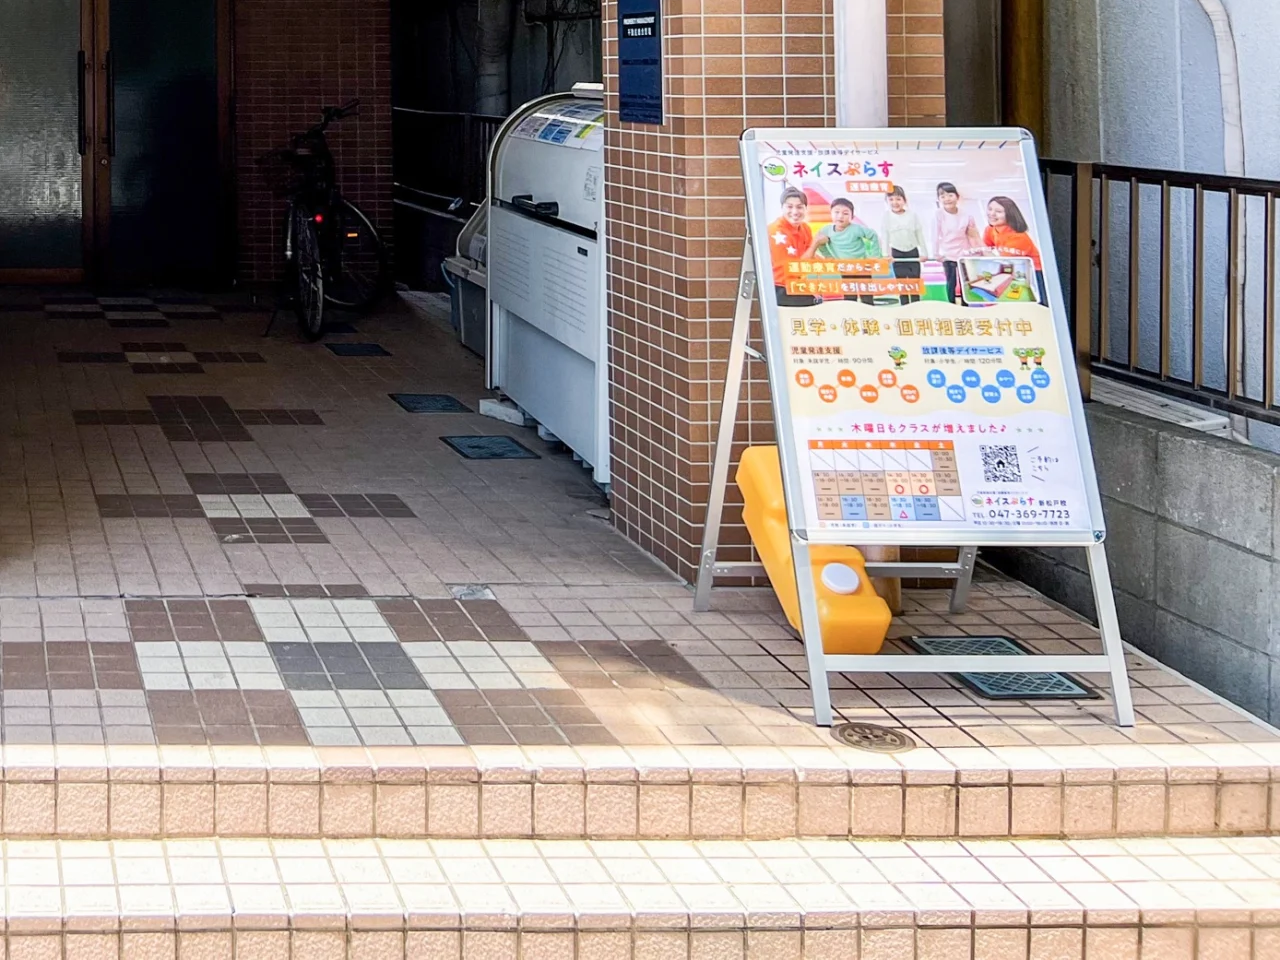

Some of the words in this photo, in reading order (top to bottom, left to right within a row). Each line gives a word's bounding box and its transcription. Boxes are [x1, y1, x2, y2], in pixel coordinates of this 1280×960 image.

[792, 160, 894, 178] ネイスぷらす
[791, 346, 842, 356] 児童発達支援
[921, 346, 1004, 356] 放課後等デイサービス
[988, 509, 1070, 519] 047-369-7723
